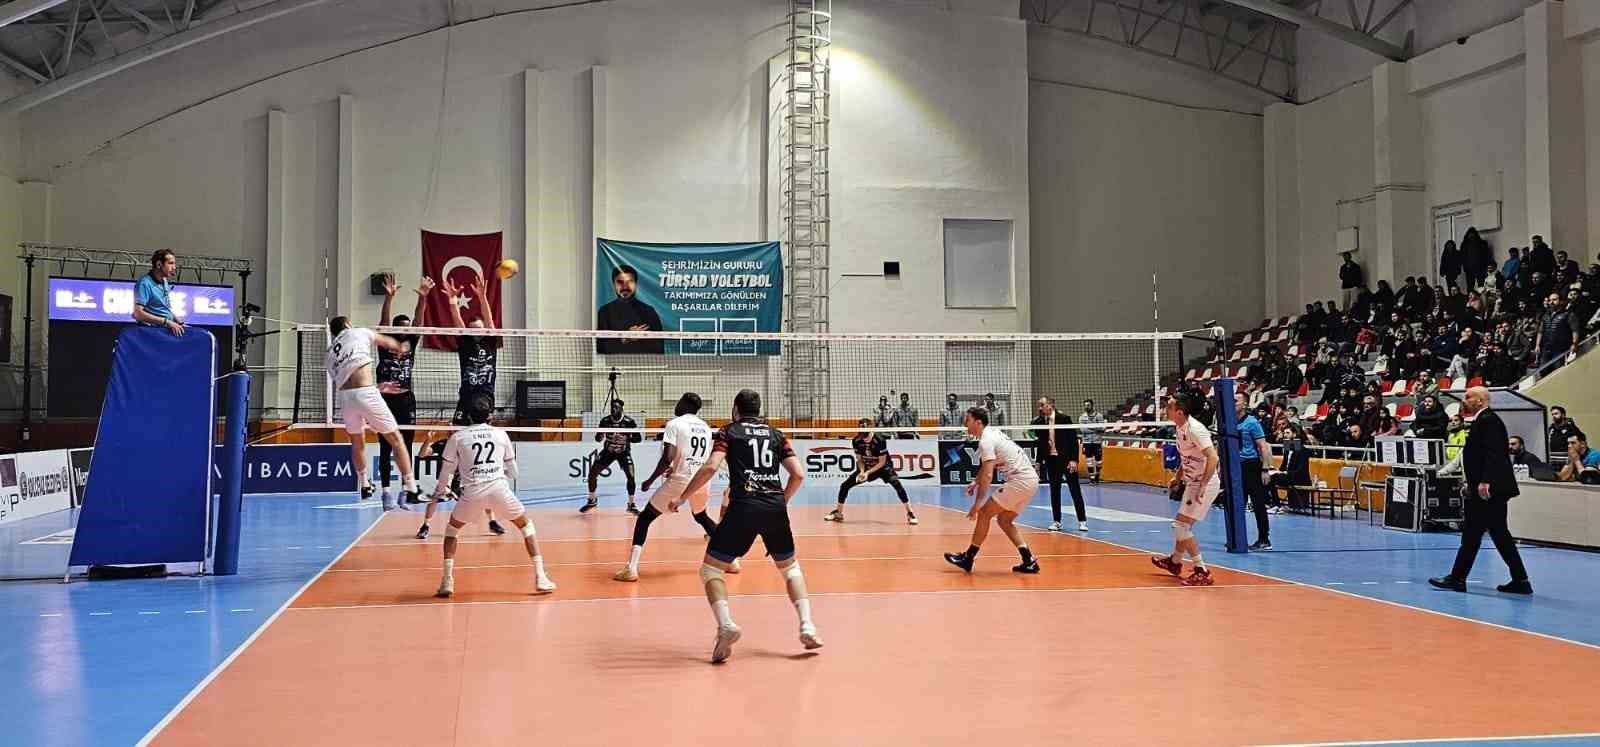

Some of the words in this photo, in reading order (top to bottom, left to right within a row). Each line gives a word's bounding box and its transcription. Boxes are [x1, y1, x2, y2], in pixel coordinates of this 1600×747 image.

[661, 260, 721, 271] ŞEHRİMİZİN
[723, 261, 763, 270] GURURU
[658, 271, 708, 290] TÜRŞAD
[710, 273, 773, 288] VOLEYBOL
[664, 292, 719, 300] TAKIMIMIZA
[720, 290, 767, 300] GÖNÜLDEN
[671, 303, 723, 313] BAŞARILAR
[724, 301, 760, 311] DİLERİM
[471, 441, 496, 465] 22
[690, 436, 706, 457] 99
[748, 438, 773, 468] 16
[806, 454, 856, 473] SPO
[888, 454, 936, 472] OTO
